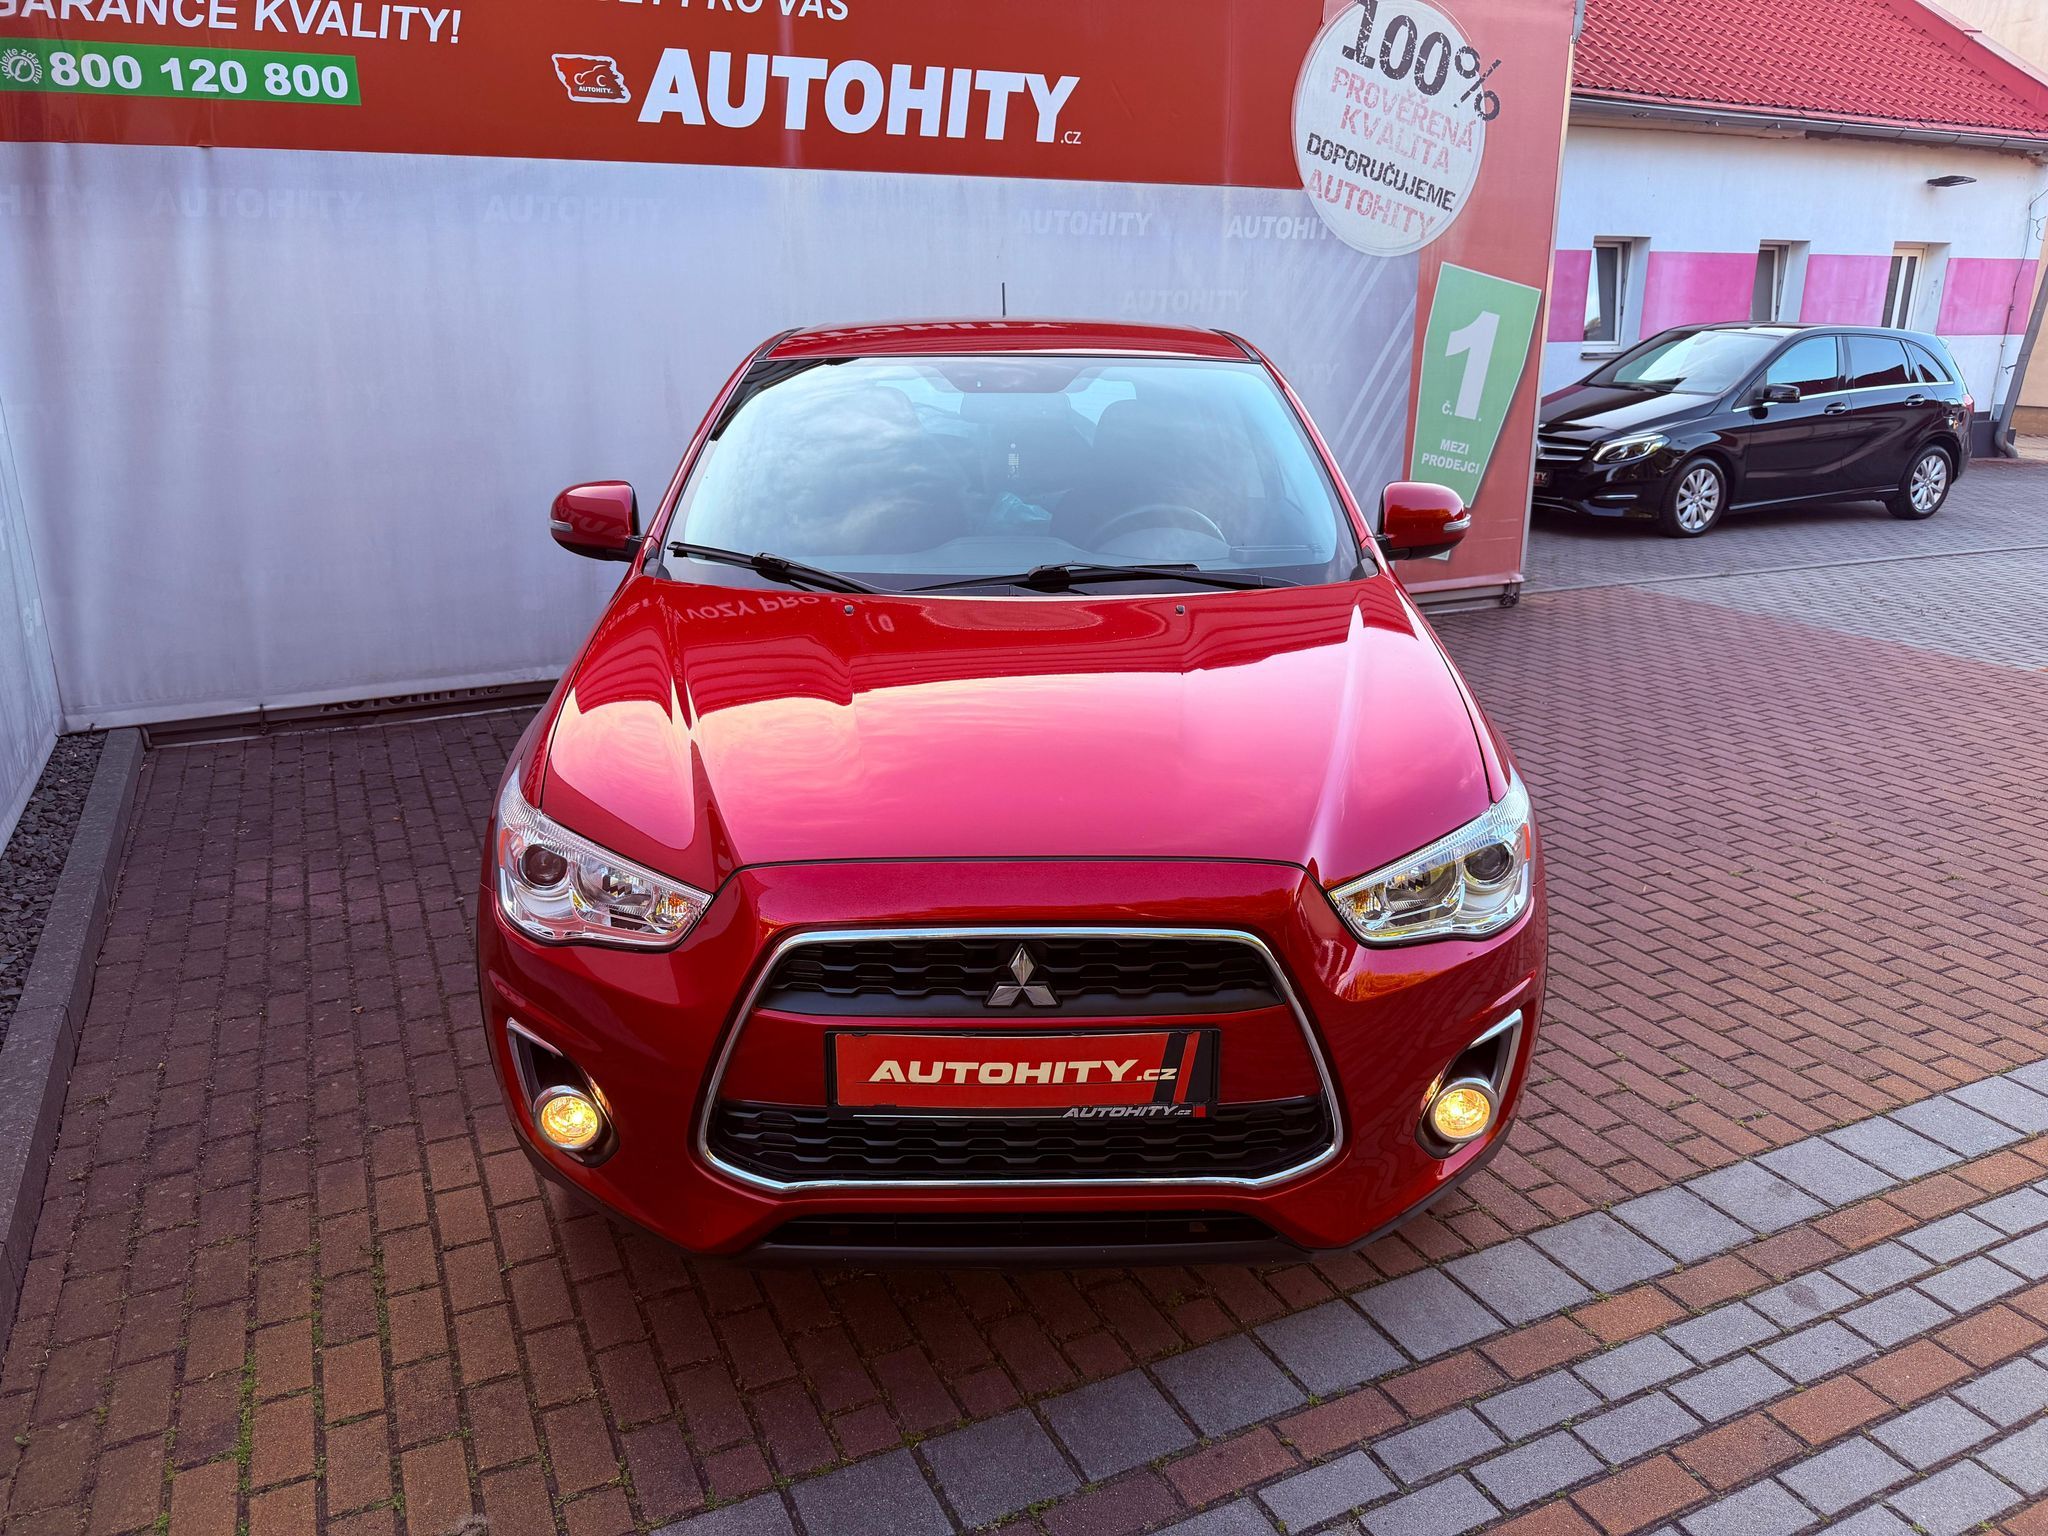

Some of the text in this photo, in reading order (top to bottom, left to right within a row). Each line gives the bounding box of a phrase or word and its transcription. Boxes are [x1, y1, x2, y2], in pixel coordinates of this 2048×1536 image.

[254, 0, 462, 44] KVALITY!
[50, 51, 349, 99] 800 120 800
[1341, 0, 1502, 121] 100%
[1340, 105, 1449, 174] KVALITA
[1306, 132, 1456, 212] DOPORUČUJEME
[150, 186, 364, 219] AUTOHITY
[482, 194, 667, 226] AUTOHITY
[1307, 169, 1437, 240] AUTOHITY
[1017, 209, 1153, 236] AUTOHITY
[1224, 214, 1341, 241] AUTOHIT
[1122, 289, 1248, 315] AUTOHITY
[1421, 452, 1480, 474] PRODEJCI
[1440, 438, 1470, 456] MEZI
